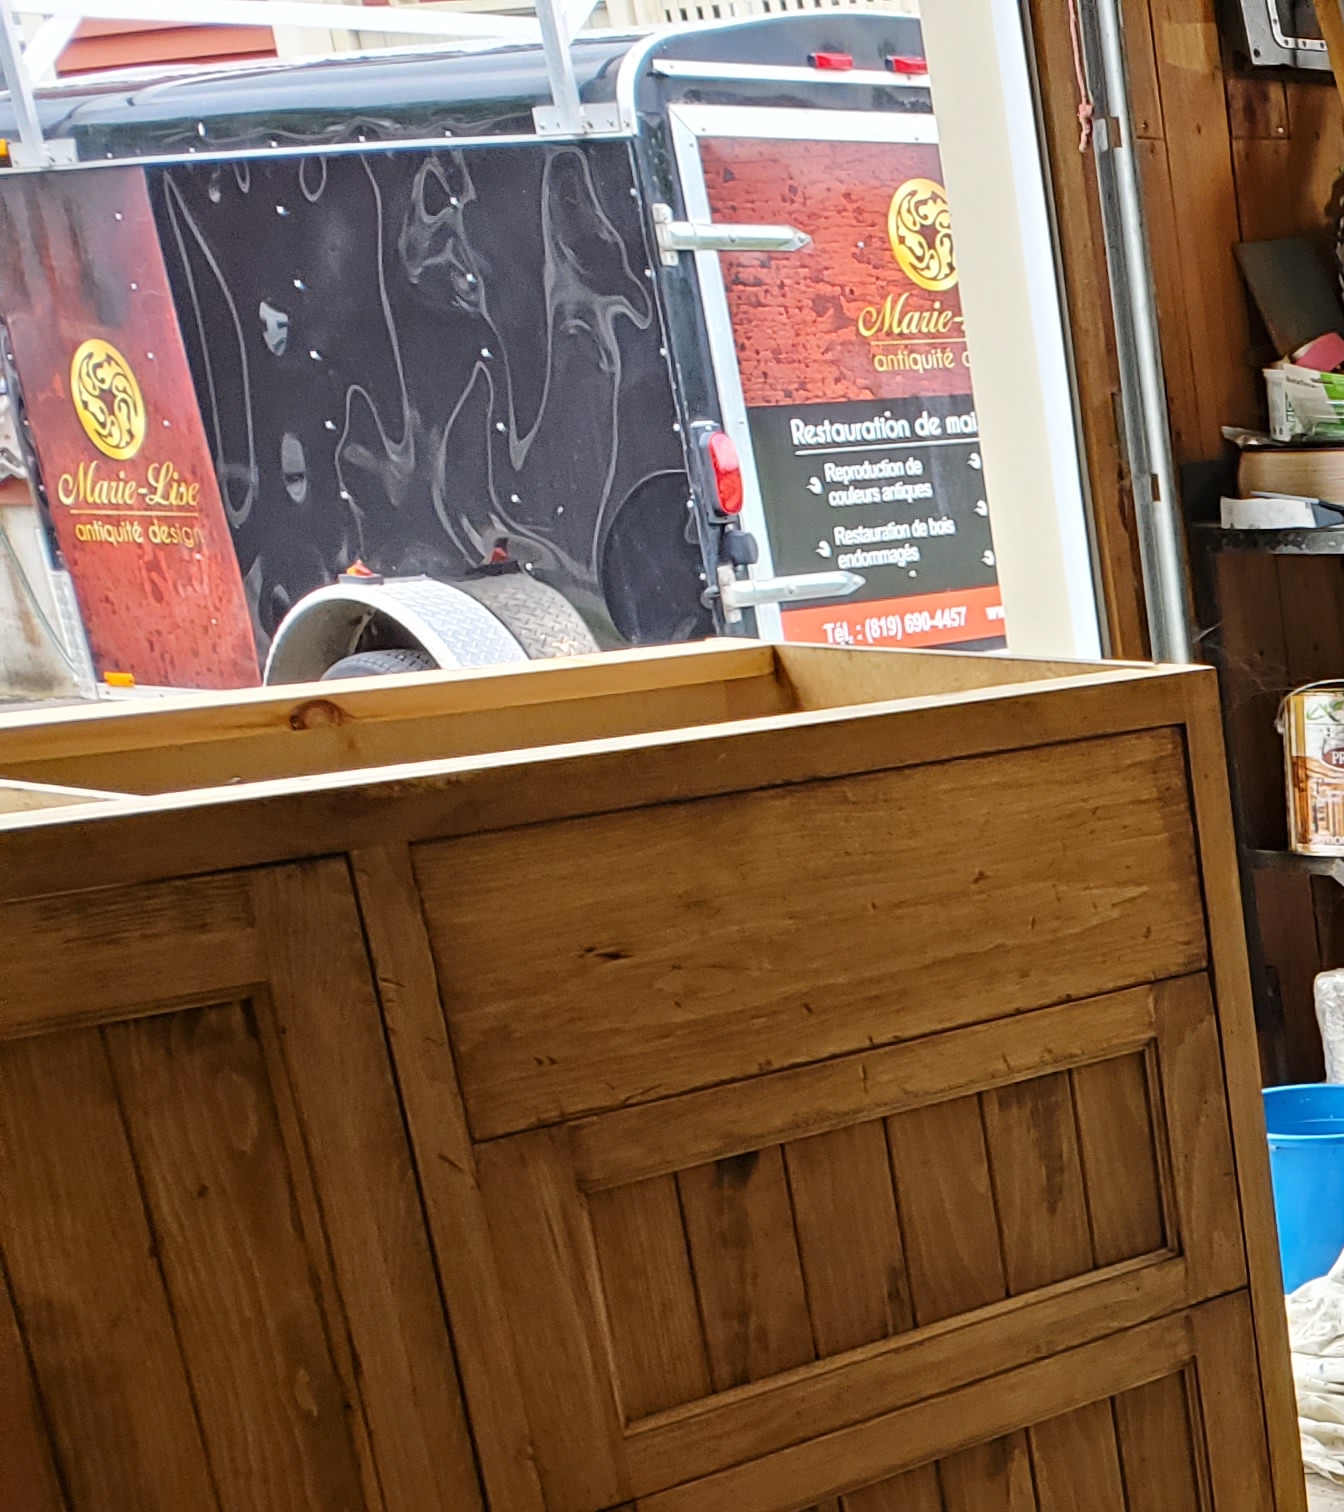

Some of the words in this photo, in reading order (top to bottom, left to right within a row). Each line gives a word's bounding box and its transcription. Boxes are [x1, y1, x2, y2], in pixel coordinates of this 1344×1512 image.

[857, 292, 966, 338] Marie-
[873, 347, 955, 374] antiquité
[790, 410, 911, 447] Restauration
[914, 410, 942, 437] de
[945, 411, 979, 434] mai
[823, 458, 905, 485] Reproduction
[905, 456, 924, 477] de
[828, 486, 882, 507] couleurs
[882, 481, 933, 503] antiques
[75, 520, 144, 546] antiquité
[149, 519, 202, 548] design
[833, 521, 910, 546] Restauration
[911, 519, 929, 537] de
[928, 516, 957, 536] bois
[837, 543, 921, 569] endommagés
[864, 614, 903, 644] (819)
[904, 606, 967, 634] 690-4457
